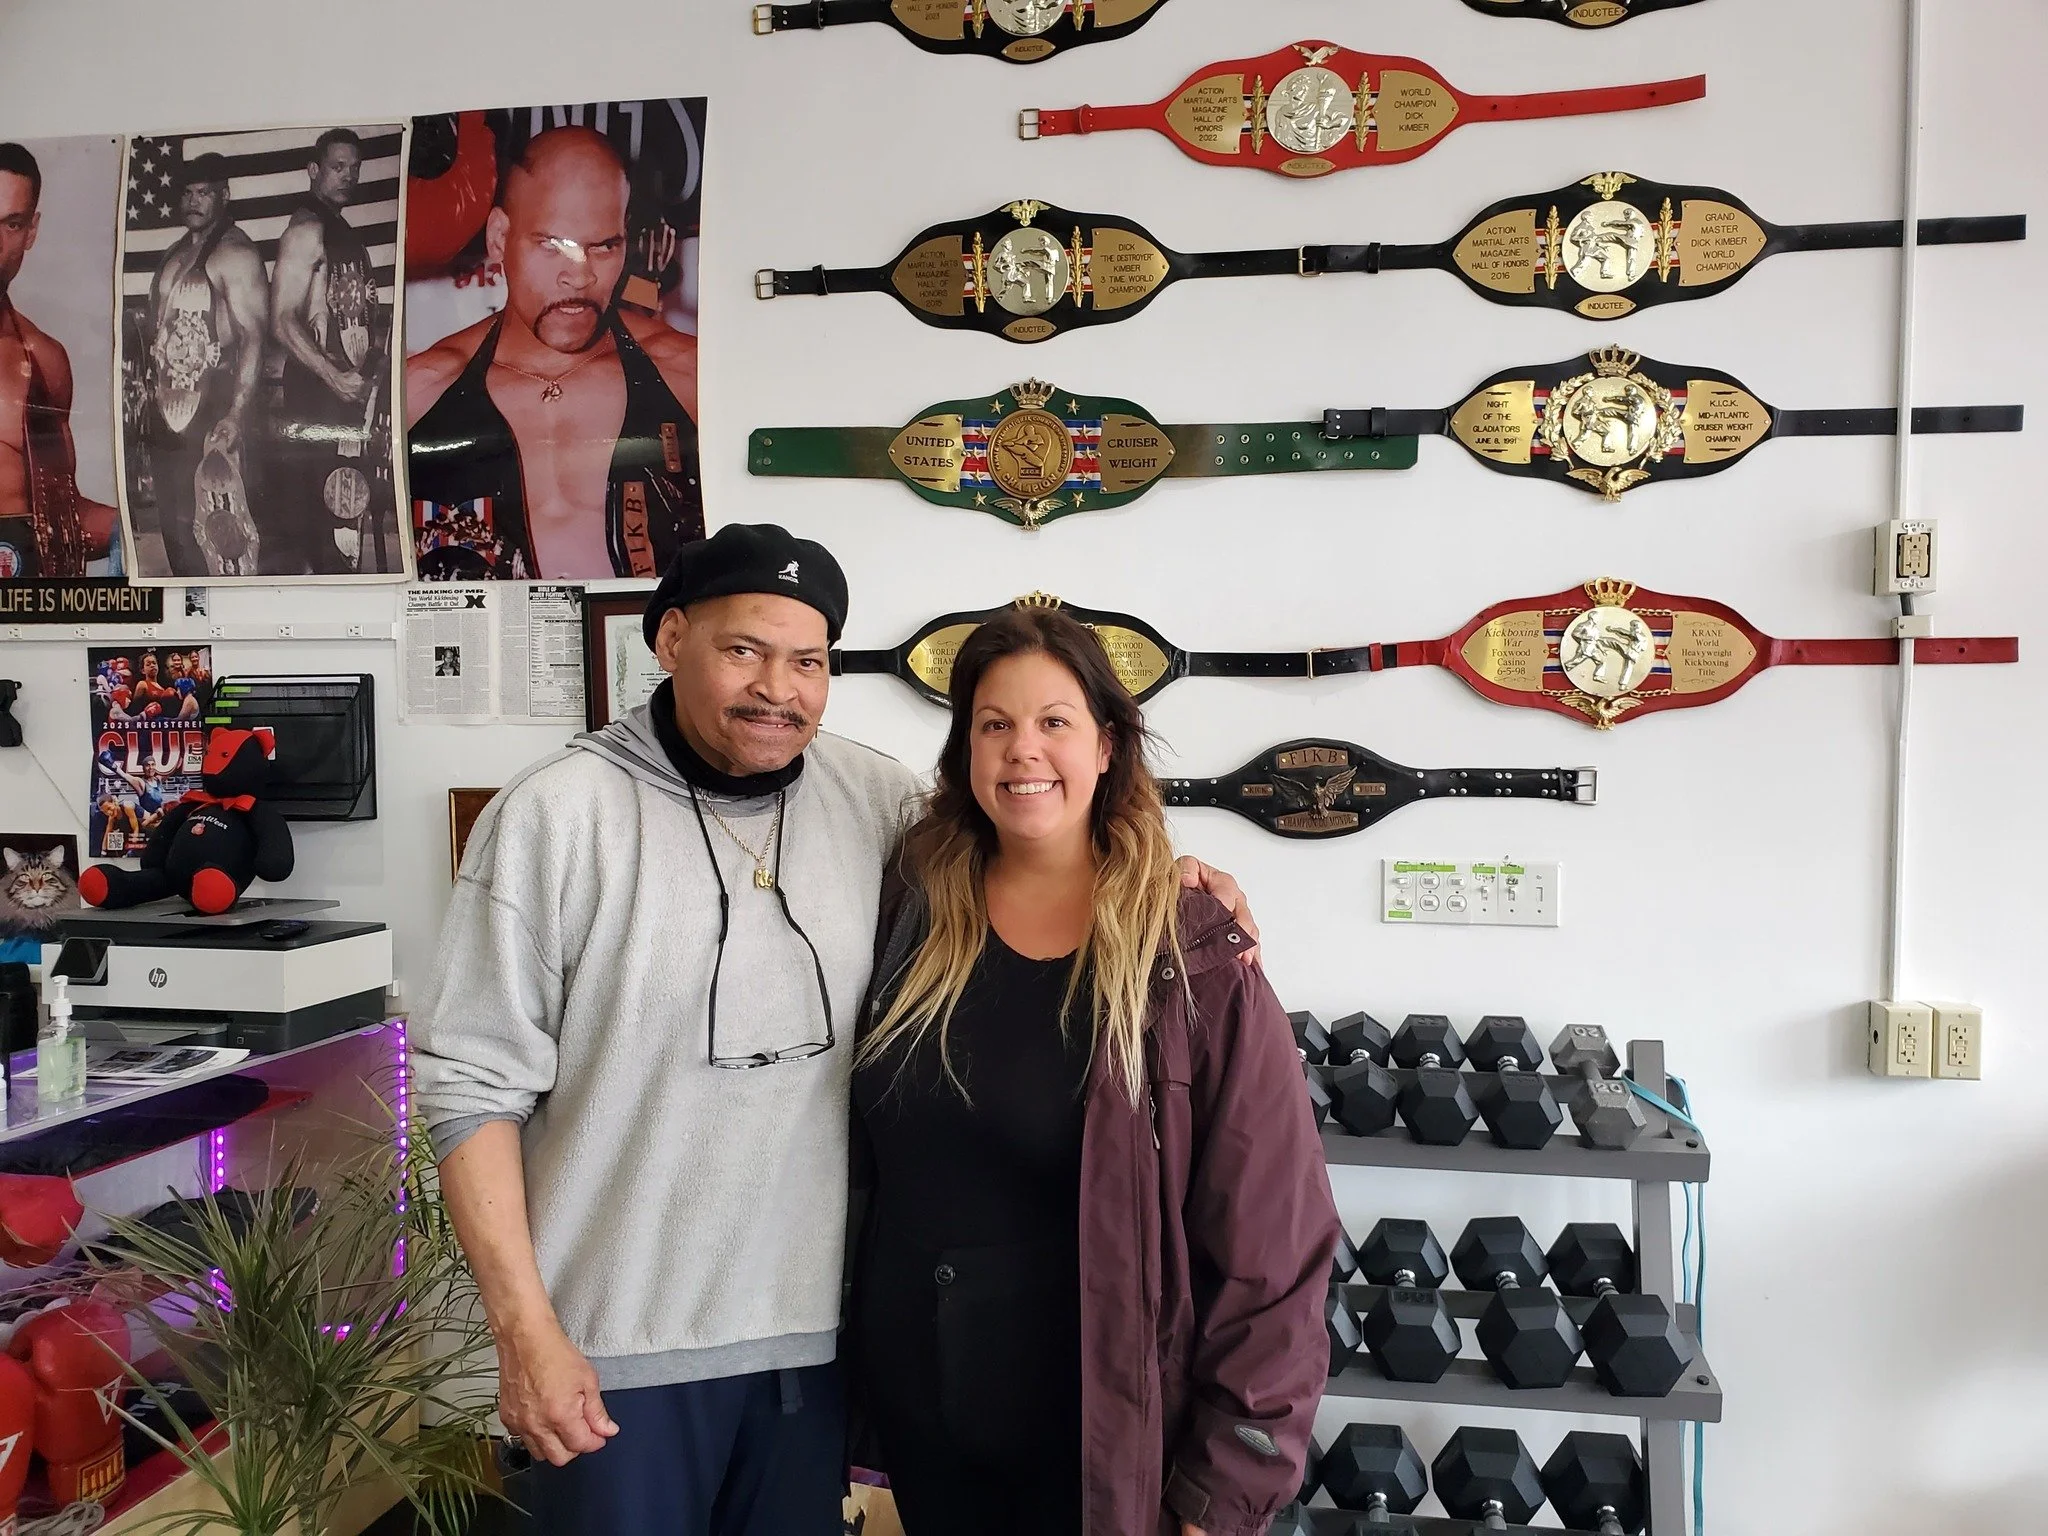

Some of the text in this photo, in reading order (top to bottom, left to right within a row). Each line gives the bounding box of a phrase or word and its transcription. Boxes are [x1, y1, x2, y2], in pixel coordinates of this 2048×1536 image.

[1573, 6, 1621, 18] INDUCTEE
[1197, 87, 1225, 95] ACTION
[1400, 88, 1431, 97] WORLD
[1183, 96, 1238, 104] MARTIAL ARTS
[1393, 100, 1437, 109] CHAMPION
[1191, 106, 1228, 114] MAGAZINE
[1193, 115, 1226, 123] HALL OF
[1404, 112, 1424, 120] DICK
[1194, 124, 1223, 132] HONORS
[1398, 124, 1430, 132] KIMBER
[1198, 134, 1218, 142] 2022
[1704, 212, 1736, 222] GRAND
[1486, 226, 1517, 235] ACTION
[1700, 224, 1739, 234] MASTER
[1472, 236, 1530, 247] MARTIAL ARTS
[1690, 236, 1748, 248] DICK KIMBER
[1118, 243, 1136, 252] DICK
[920, 250, 946, 260] ACTION
[1479, 248, 1521, 258] MAGAZINE
[1702, 249, 1735, 259] WORLD
[1113, 264, 1141, 273] KIMBER
[1471, 259, 1530, 270] HALL OF HONORS
[1695, 261, 1742, 272] CHAMPION
[1100, 274, 1154, 284] 3 TIME WORLD
[1490, 272, 1510, 281] 2016
[1108, 285, 1147, 294] CHAMPION
[1587, 302, 1624, 310] INDUCTEE
[1013, 325, 1046, 334] INDUCTEE
[1486, 400, 1509, 408] NIGHT
[1709, 399, 1739, 408] K.I.C.K.
[1482, 413, 1512, 421] OF THE
[1698, 411, 1750, 419] MID-ATLANTIC
[1472, 425, 1521, 433] GLADIATORS
[1693, 422, 1754, 431] CRUISER WEIGHT
[905, 435, 955, 448] UNITED
[1107, 437, 1159, 449] CRUISER
[1474, 437, 1492, 445] JUNE
[1503, 437, 1517, 445] 1991
[1705, 435, 1742, 443] CHAMPION
[903, 454, 955, 468] STATES
[1108, 457, 1158, 470] WEIGHT
[1002, 473, 1058, 493] CHAMPION
[626, 498, 653, 577] FIKB
[778, 574, 800, 584] KANGOL
[0, 587, 153, 612] LIFE IS MOVEMENT
[464, 594, 487, 609] X
[1484, 628, 1540, 638] Kickboxing
[1691, 629, 1723, 637] KRANE
[1503, 638, 1523, 647] War
[1695, 639, 1719, 647] World
[929, 648, 957, 656] WORLD
[1491, 648, 1531, 657] Foxwood
[1681, 648, 1732, 658] Heavyweight
[1497, 657, 1526, 666] Casino
[1684, 659, 1729, 668] Kickboxing
[925, 666, 944, 674] DICK
[1496, 666, 1526, 675] 6-5-98
[1698, 668, 1716, 676] Title
[103, 721, 130, 730] 2025
[187, 755, 202, 763] USA
[1289, 749, 1338, 766] FIKB
[149, 967, 168, 989] hp
[1594, 1082, 1623, 1094] 20
